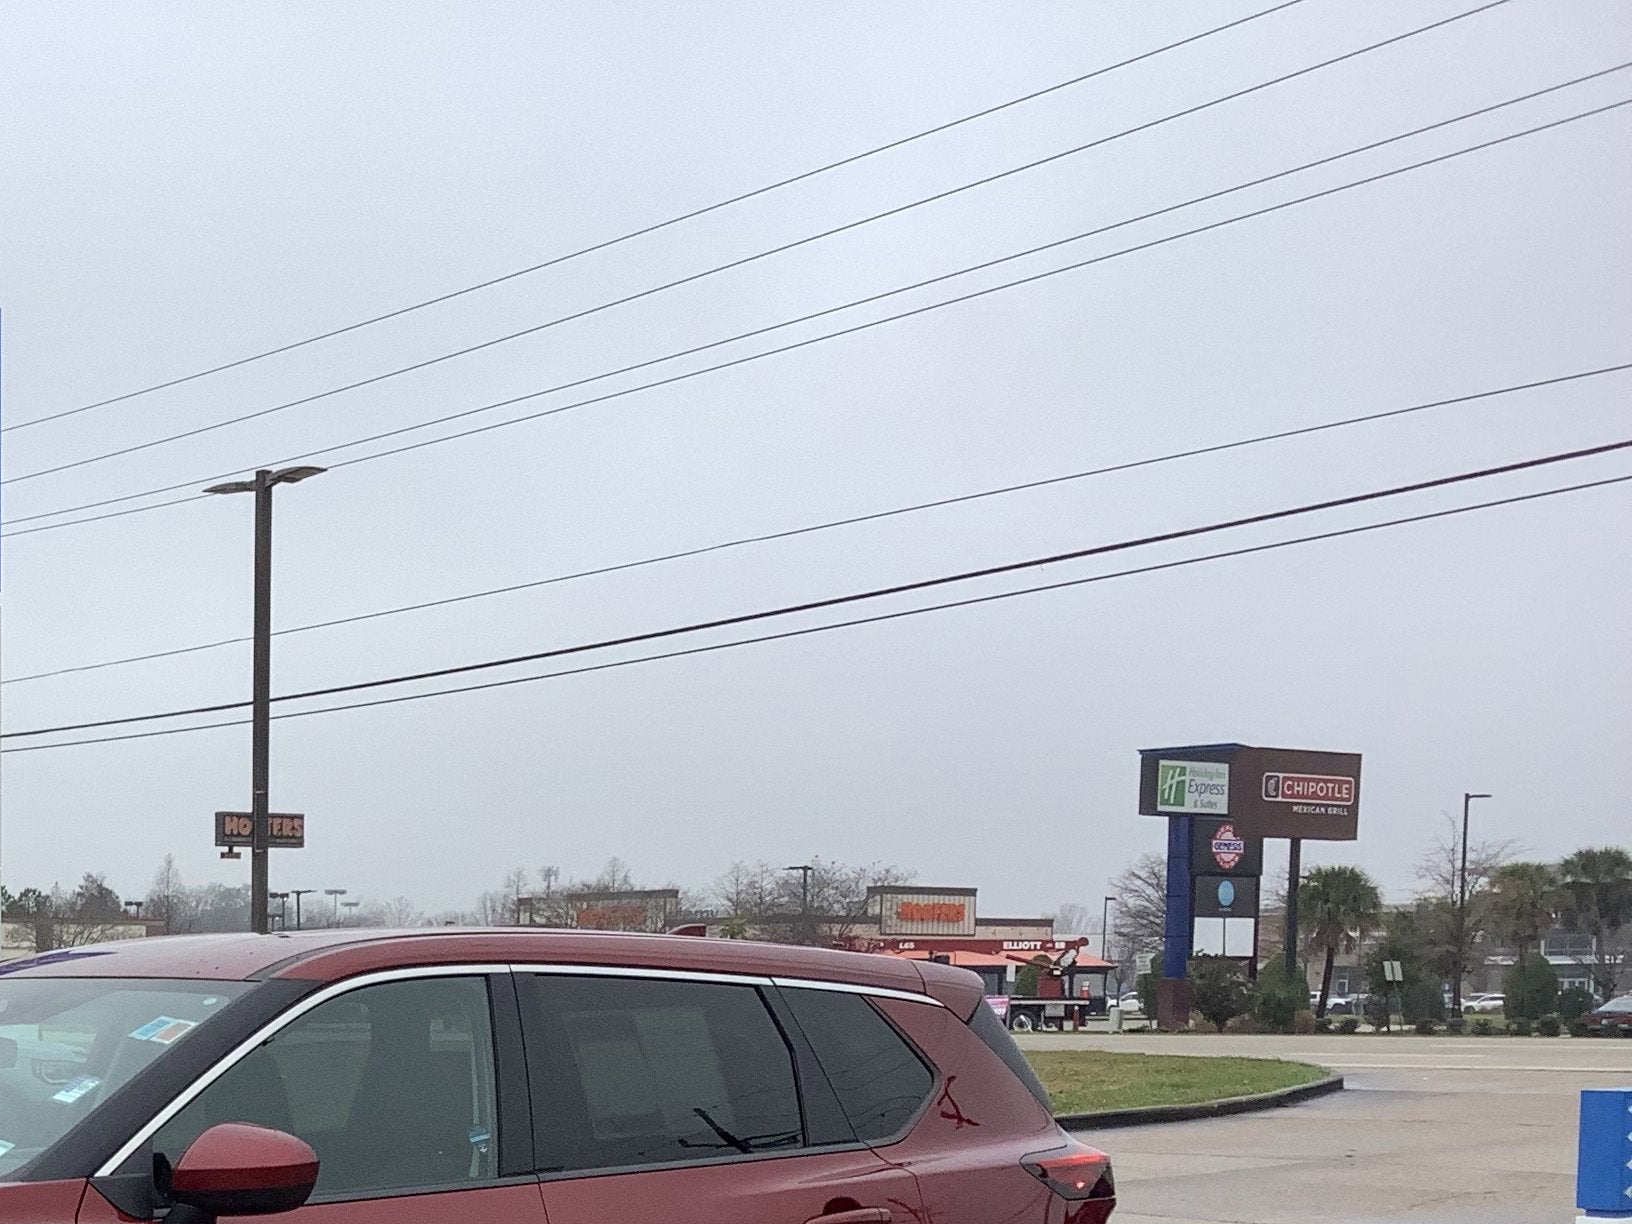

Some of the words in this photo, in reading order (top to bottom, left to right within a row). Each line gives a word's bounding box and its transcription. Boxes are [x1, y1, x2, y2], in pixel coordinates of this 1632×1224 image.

[1188, 778, 1225, 797] Express
[1283, 780, 1350, 798] CHIPOTLE
[1292, 805, 1325, 814] MEXICAN
[1327, 806, 1348, 816] GRILL
[224, 815, 303, 838] HOERS
[1002, 941, 1043, 950] ELLIOTT
